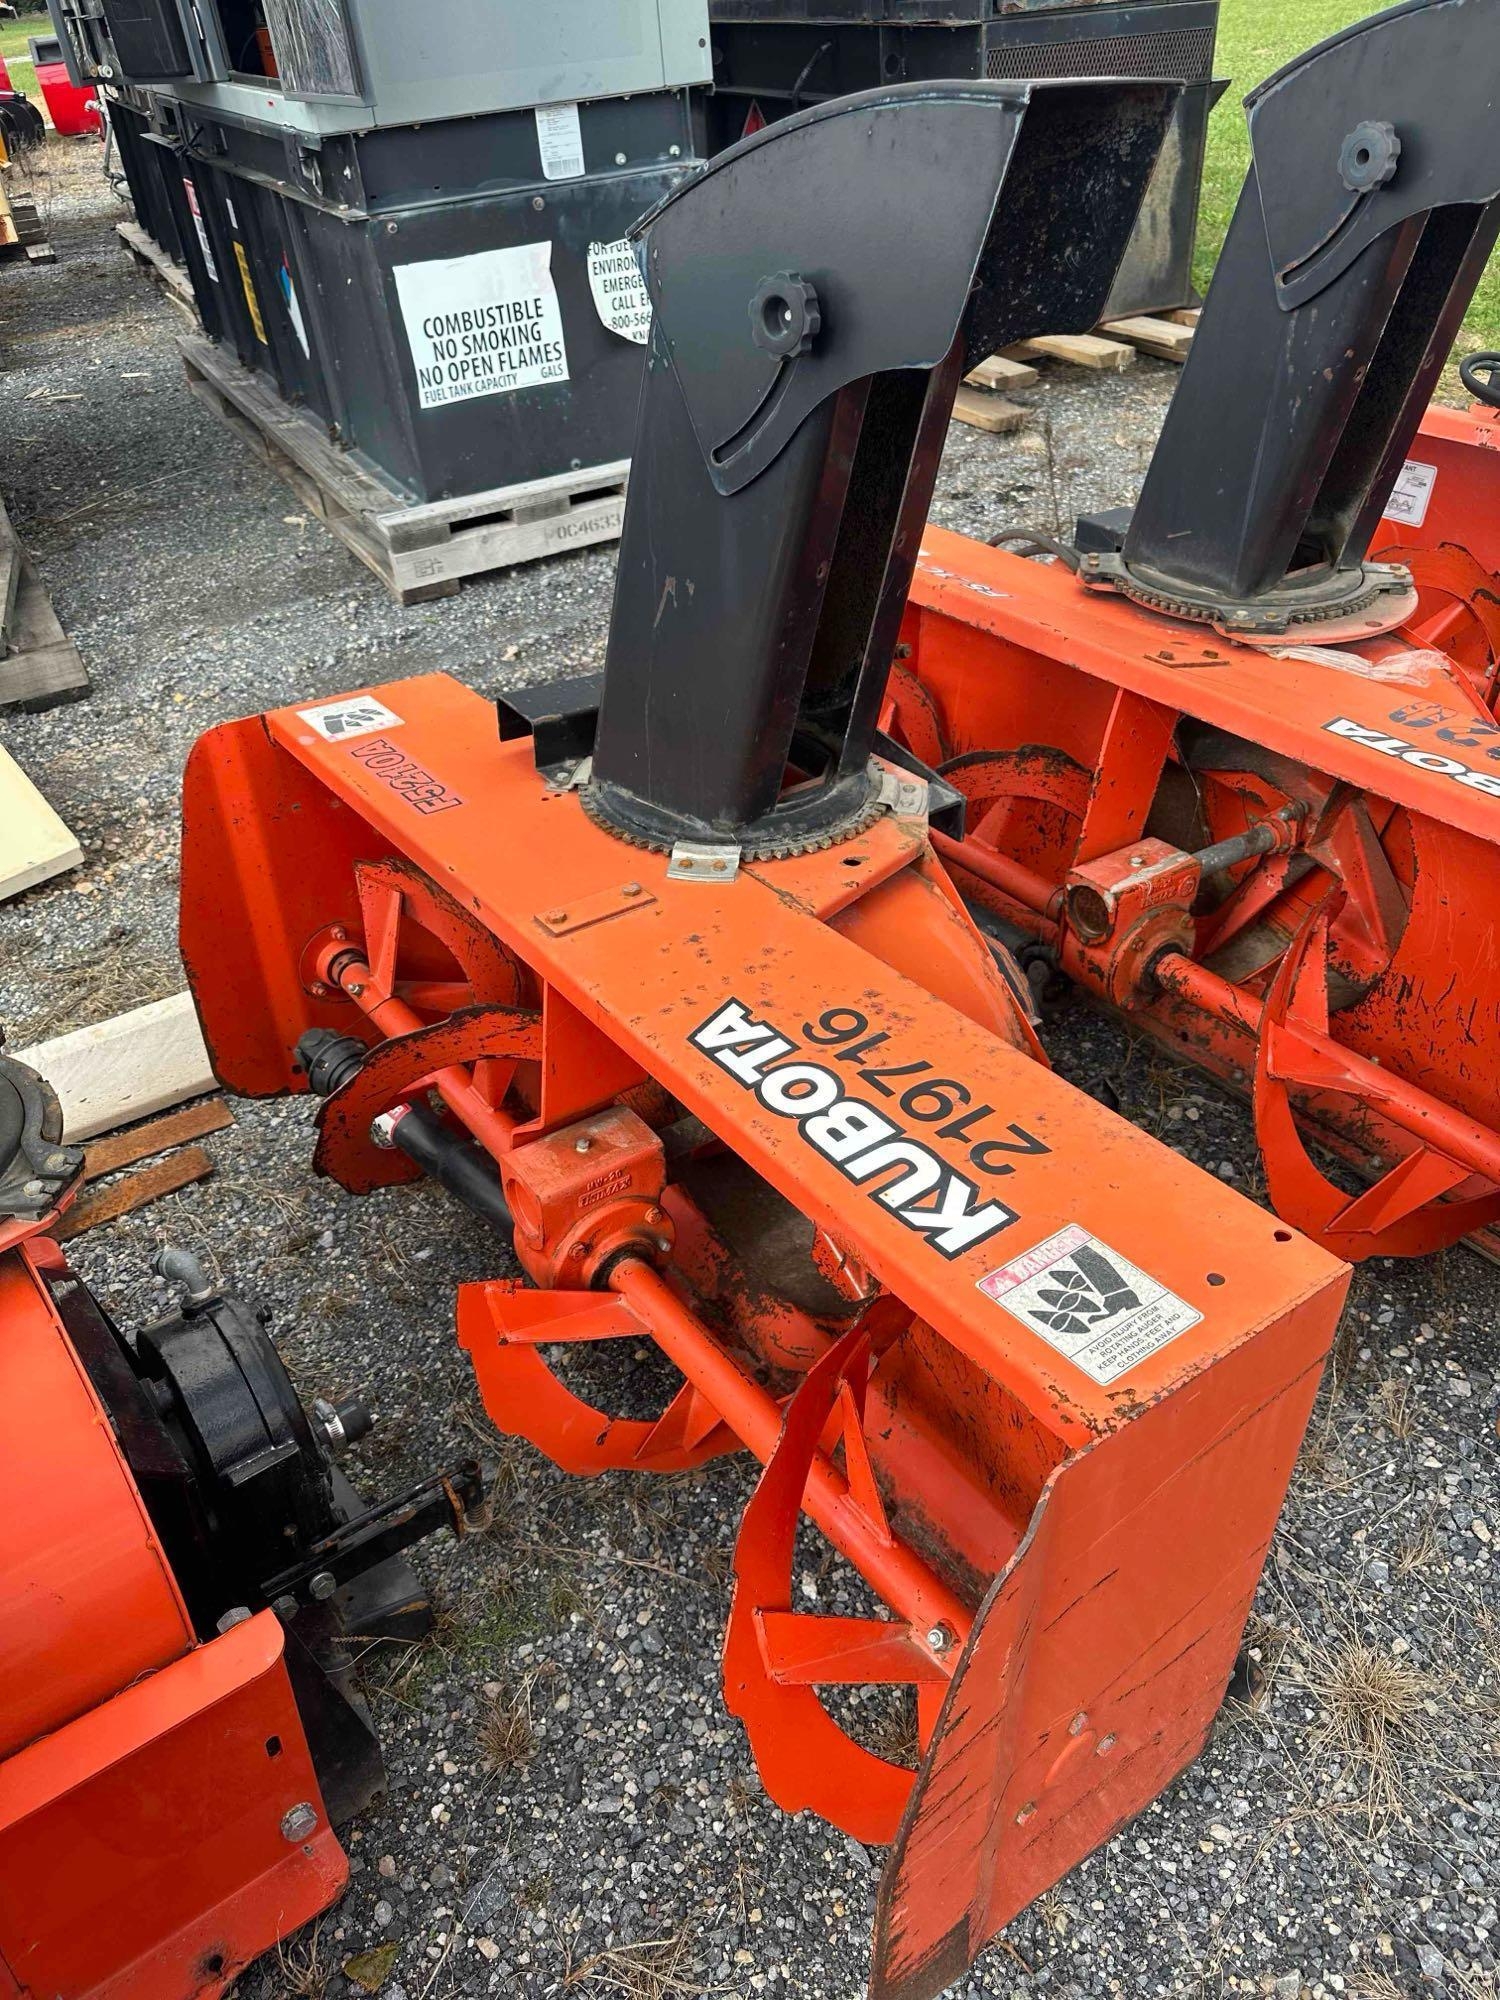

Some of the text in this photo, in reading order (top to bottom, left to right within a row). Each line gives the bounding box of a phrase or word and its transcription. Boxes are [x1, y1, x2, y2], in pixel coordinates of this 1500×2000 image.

[592, 256, 638, 276] ENVIRON
[603, 274, 644, 294] EMERGE
[423, 298, 544, 339] COMBUSTIBLE
[612, 294, 636, 311] CALL
[432, 321, 542, 362] NO SMOKING
[419, 341, 563, 389] NO OPEN FLAMES
[424, 363, 564, 404] FUEL TANK CAPACITY GALS
[351, 739, 463, 815] F5210A
[1320, 716, 1500, 797] BOTA
[802, 1007, 1053, 1176] 219716
[686, 996, 1021, 1261] KUBOTA
[1089, 1305, 1160, 1354] AVOID INJURY FROM
[1097, 1354, 1118, 1370] KEEP
[1145, 1324, 1165, 1339] FEET
[1164, 1313, 1181, 1326] AND
[1099, 1313, 1164, 1358] ROTATING AUGER
[1117, 1326, 1177, 1369] CLOTHING AWAY
